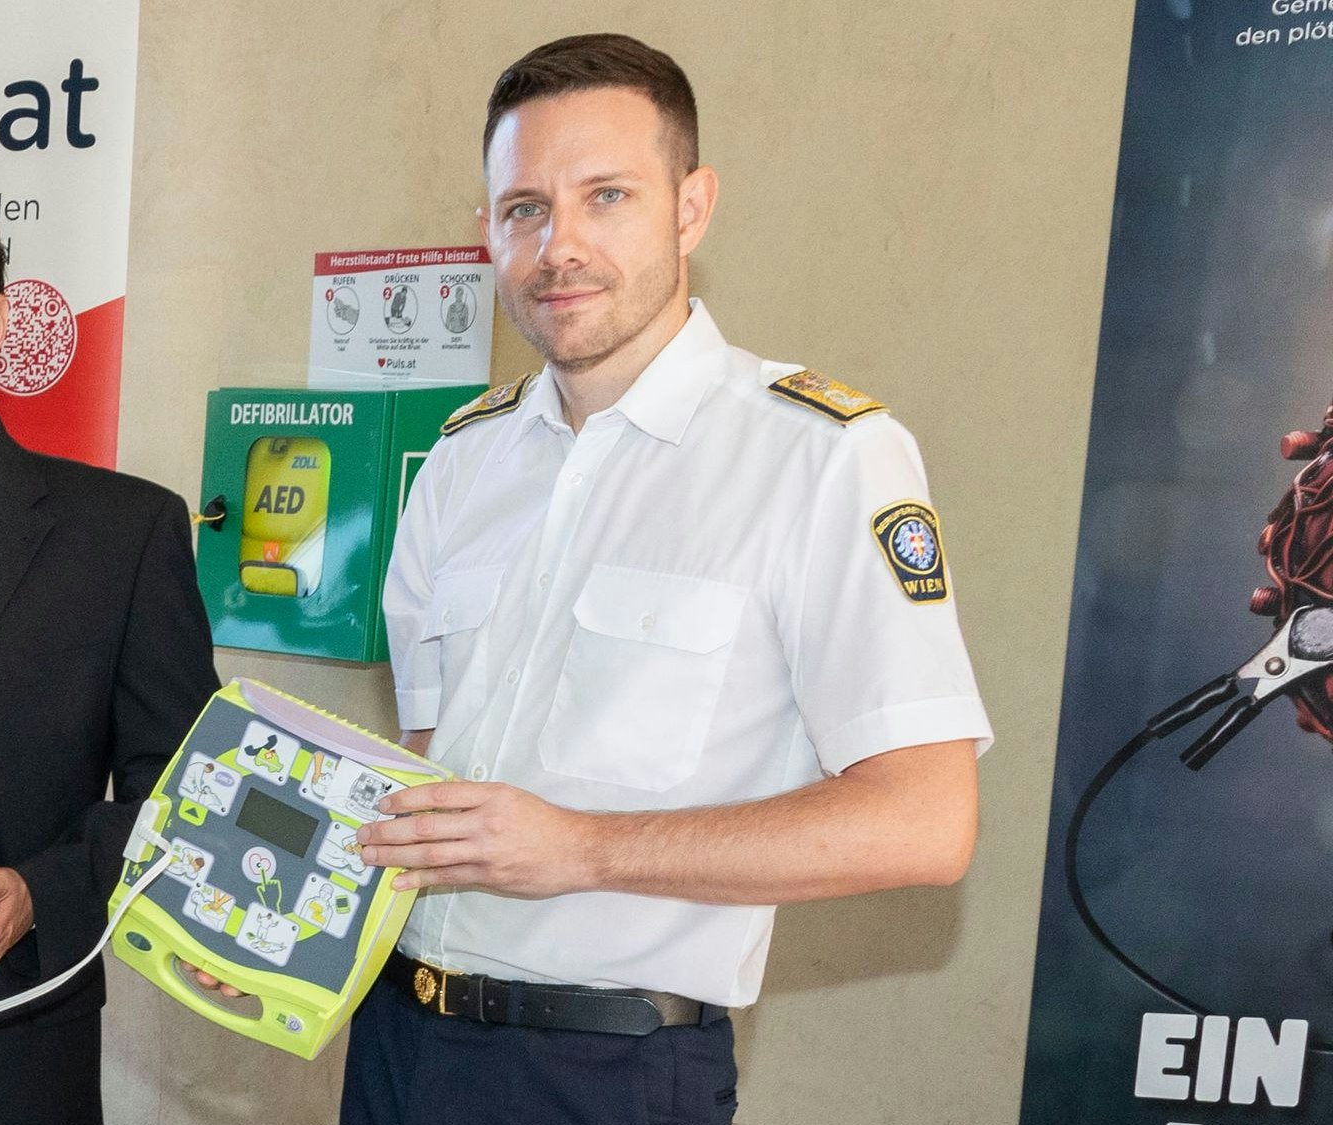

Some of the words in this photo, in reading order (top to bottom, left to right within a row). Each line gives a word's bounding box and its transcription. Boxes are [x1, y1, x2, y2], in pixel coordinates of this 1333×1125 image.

[1235, 26, 1281, 47] den
[329, 252, 395, 267] Herzstillstand?
[396, 253, 420, 264] Erste
[420, 250, 444, 263] Hilfe
[444, 249, 480, 262] leisten!
[440, 273, 482, 284] SCHOCKEN
[386, 358, 416, 369] Puls.at
[230, 402, 354, 426] DEFIBRILLATOR
[253, 484, 305, 515] AED
[903, 577, 944, 595] WIEN
[1134, 1011, 1309, 1108] EIN
